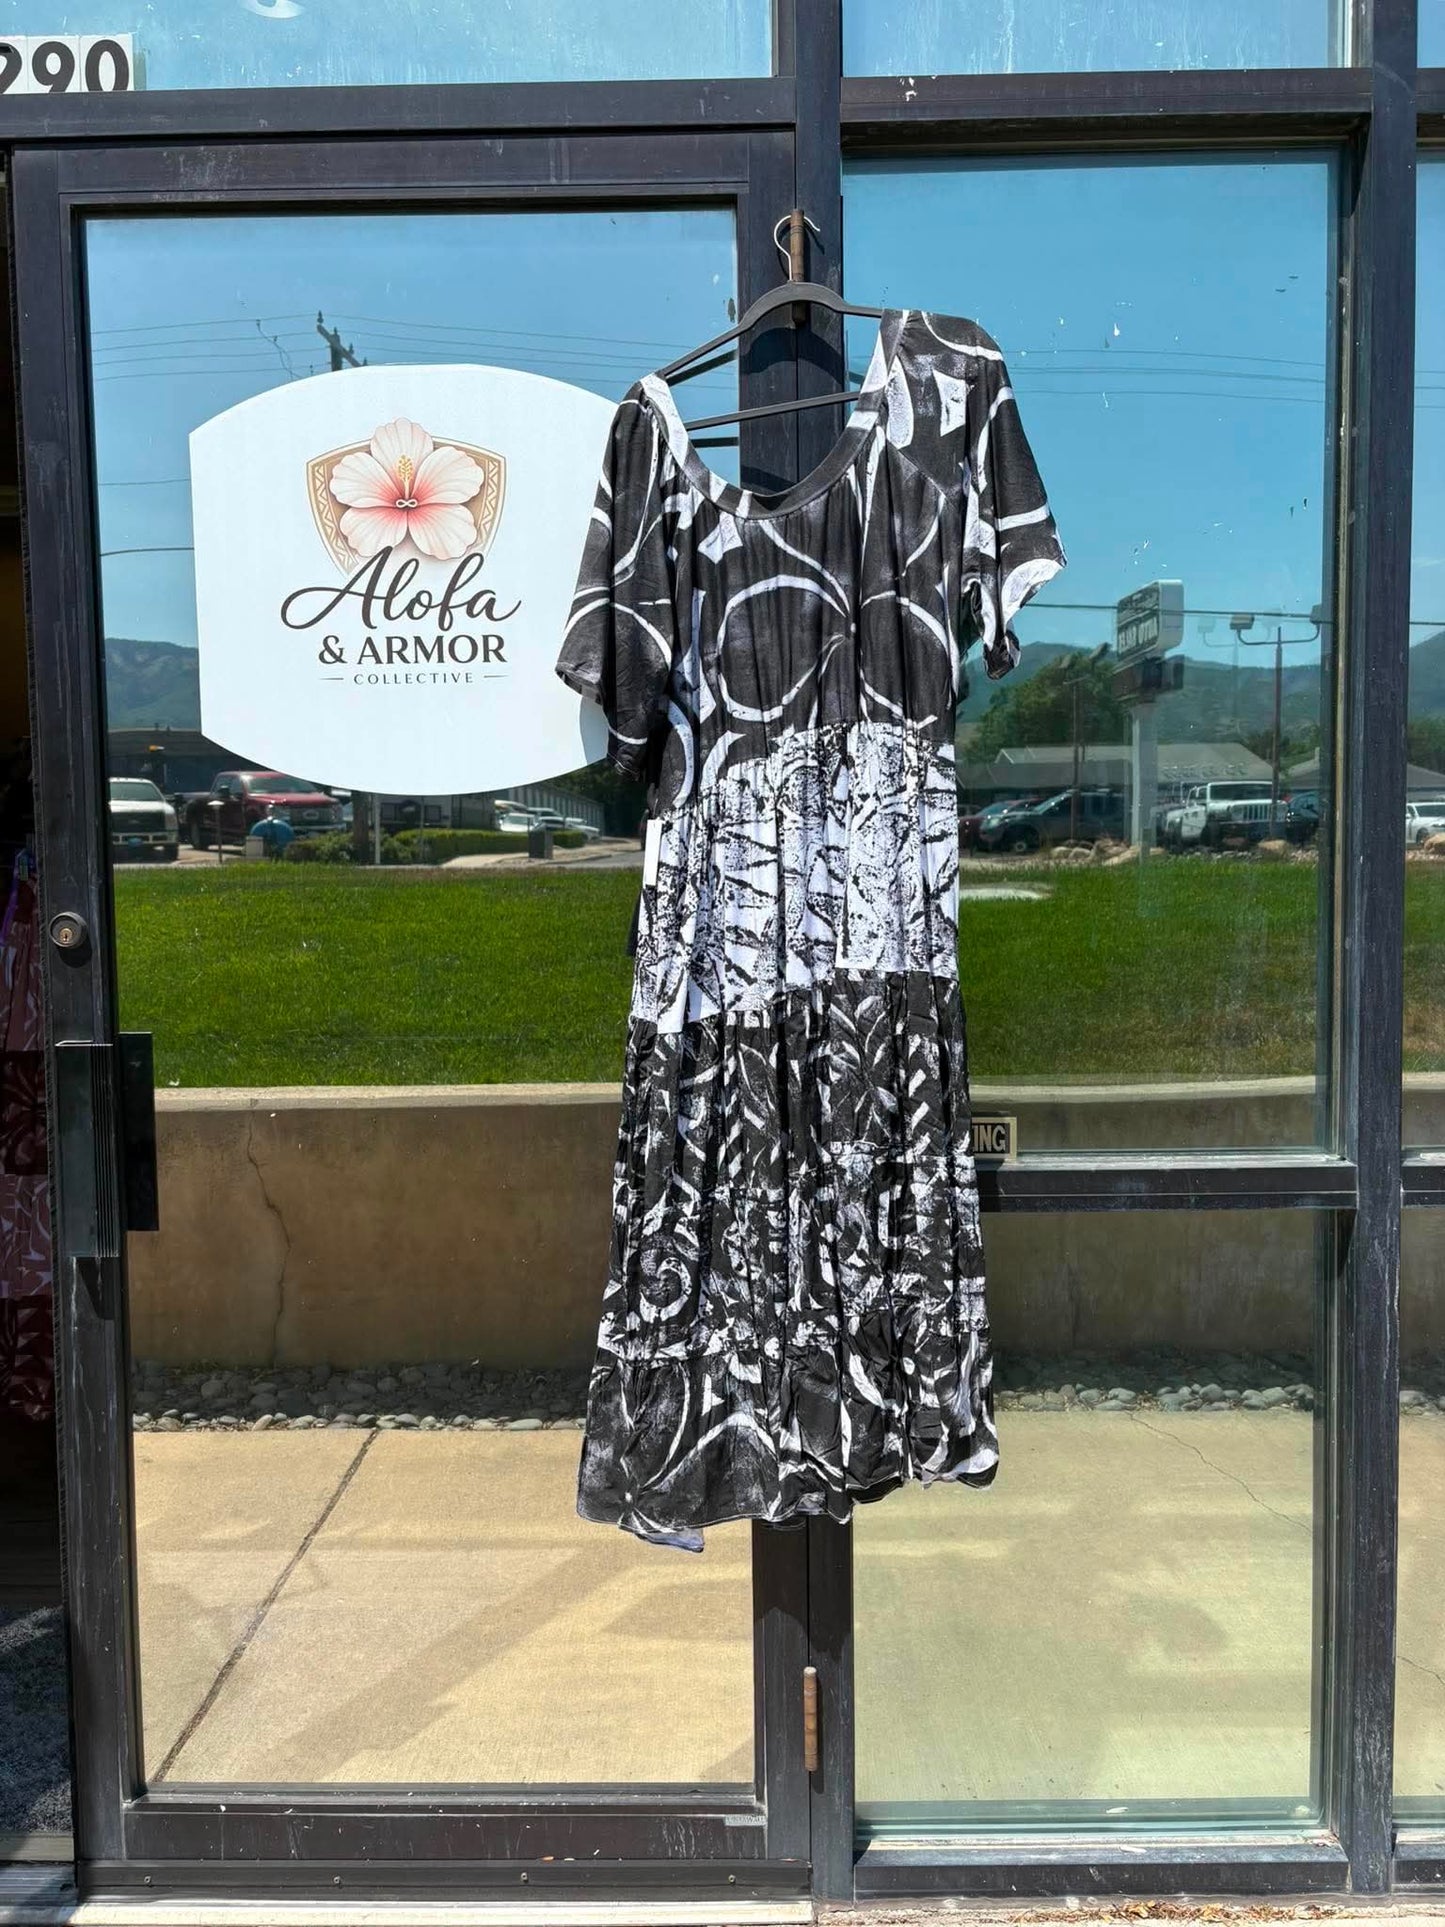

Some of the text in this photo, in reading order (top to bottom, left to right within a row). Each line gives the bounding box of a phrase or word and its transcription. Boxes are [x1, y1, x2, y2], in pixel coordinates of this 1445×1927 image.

[280, 545, 522, 632] Alofa
[318, 634, 508, 665] & ARMOR
[353, 672, 474, 685] COLLECTIVE
